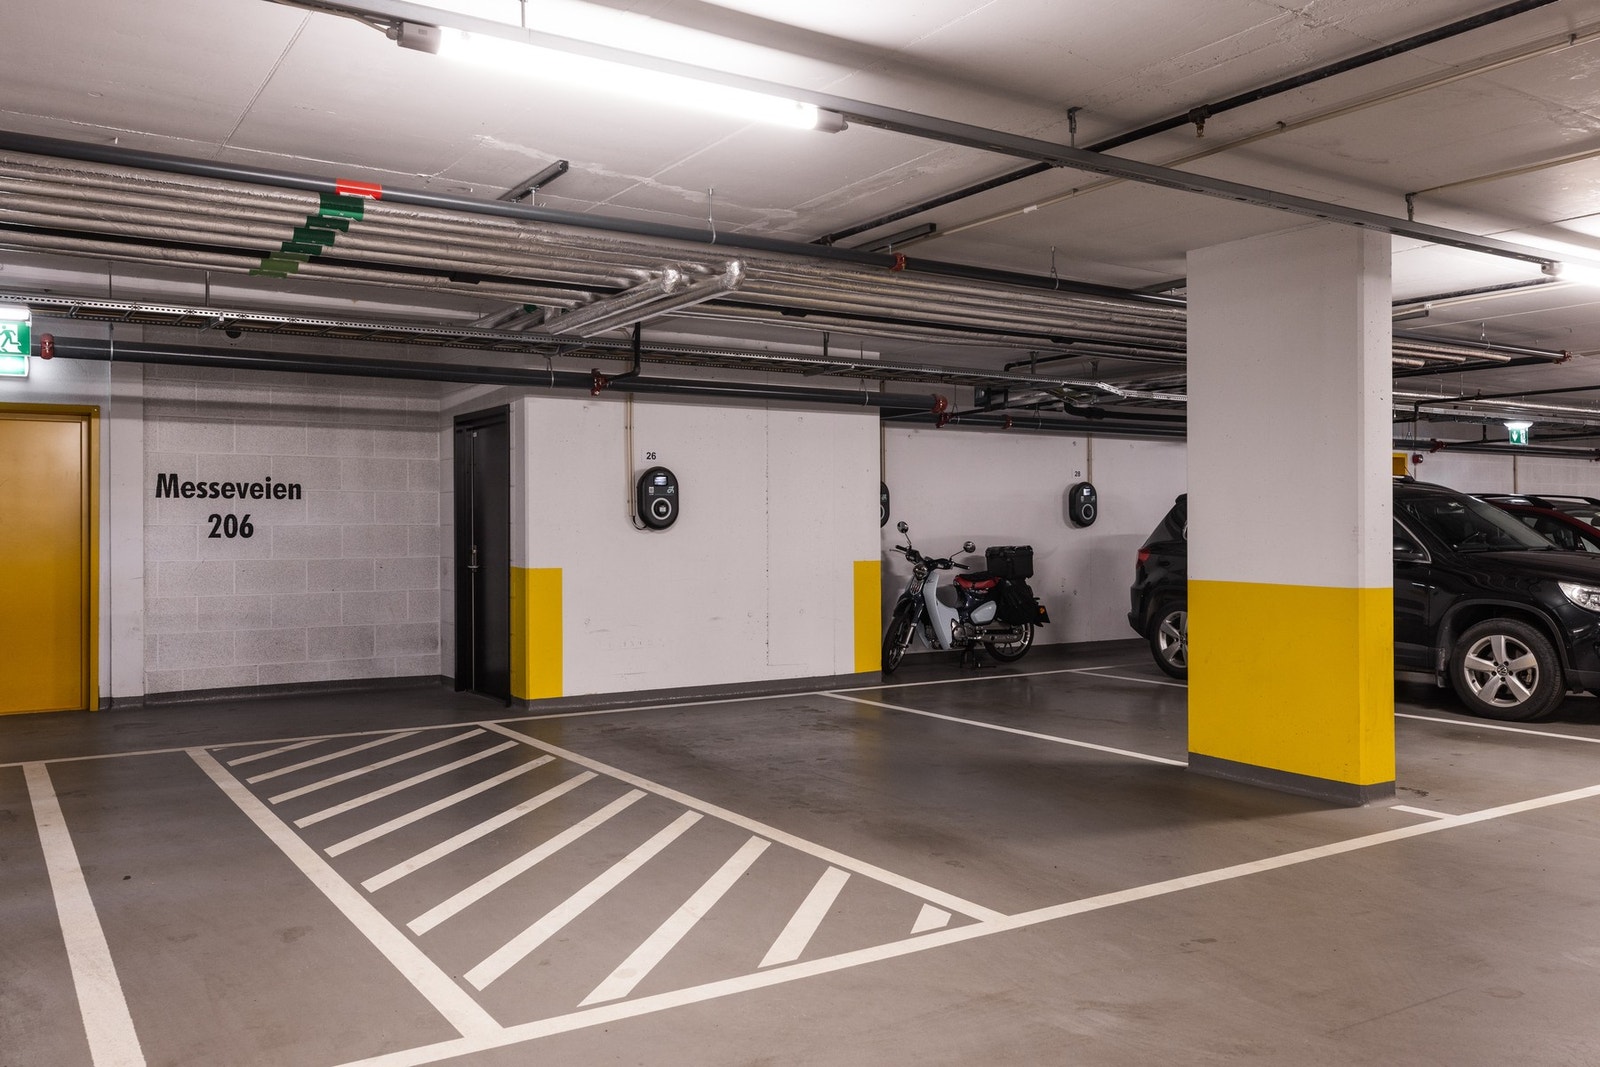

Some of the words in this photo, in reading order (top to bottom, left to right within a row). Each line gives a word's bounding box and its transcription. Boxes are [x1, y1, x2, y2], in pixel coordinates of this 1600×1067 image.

[646, 451, 657, 460] 26
[155, 473, 302, 500] Messeveien
[208, 513, 254, 539] 206
